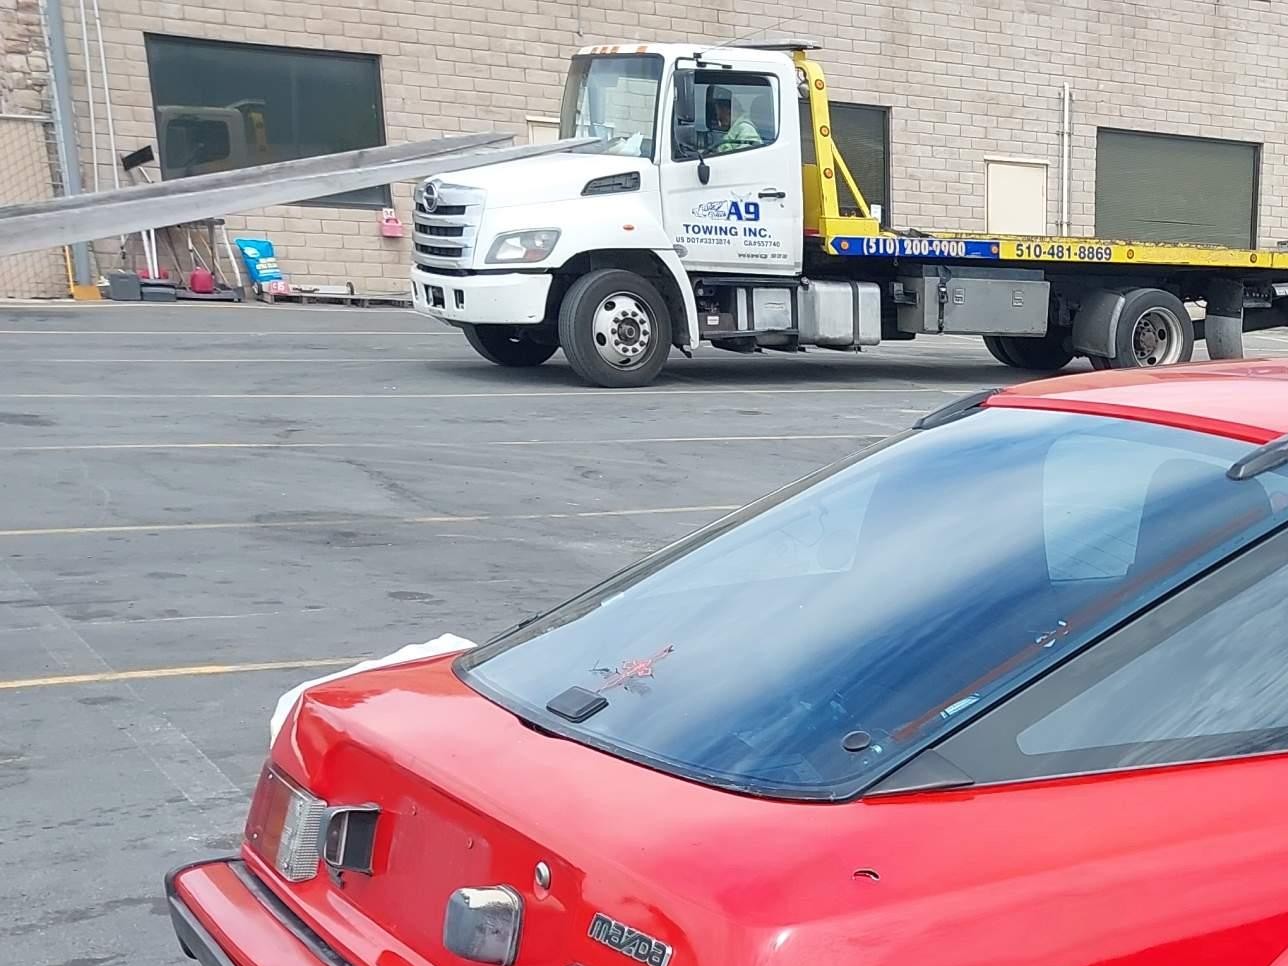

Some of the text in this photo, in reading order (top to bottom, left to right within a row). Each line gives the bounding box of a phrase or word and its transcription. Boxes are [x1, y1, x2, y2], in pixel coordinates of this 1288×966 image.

[727, 200, 760, 221] A9
[683, 224, 771, 238] TOWING INC.
[863, 238, 966, 257] (510) 200-9900
[1016, 243, 1112, 261] 510-481-8869
